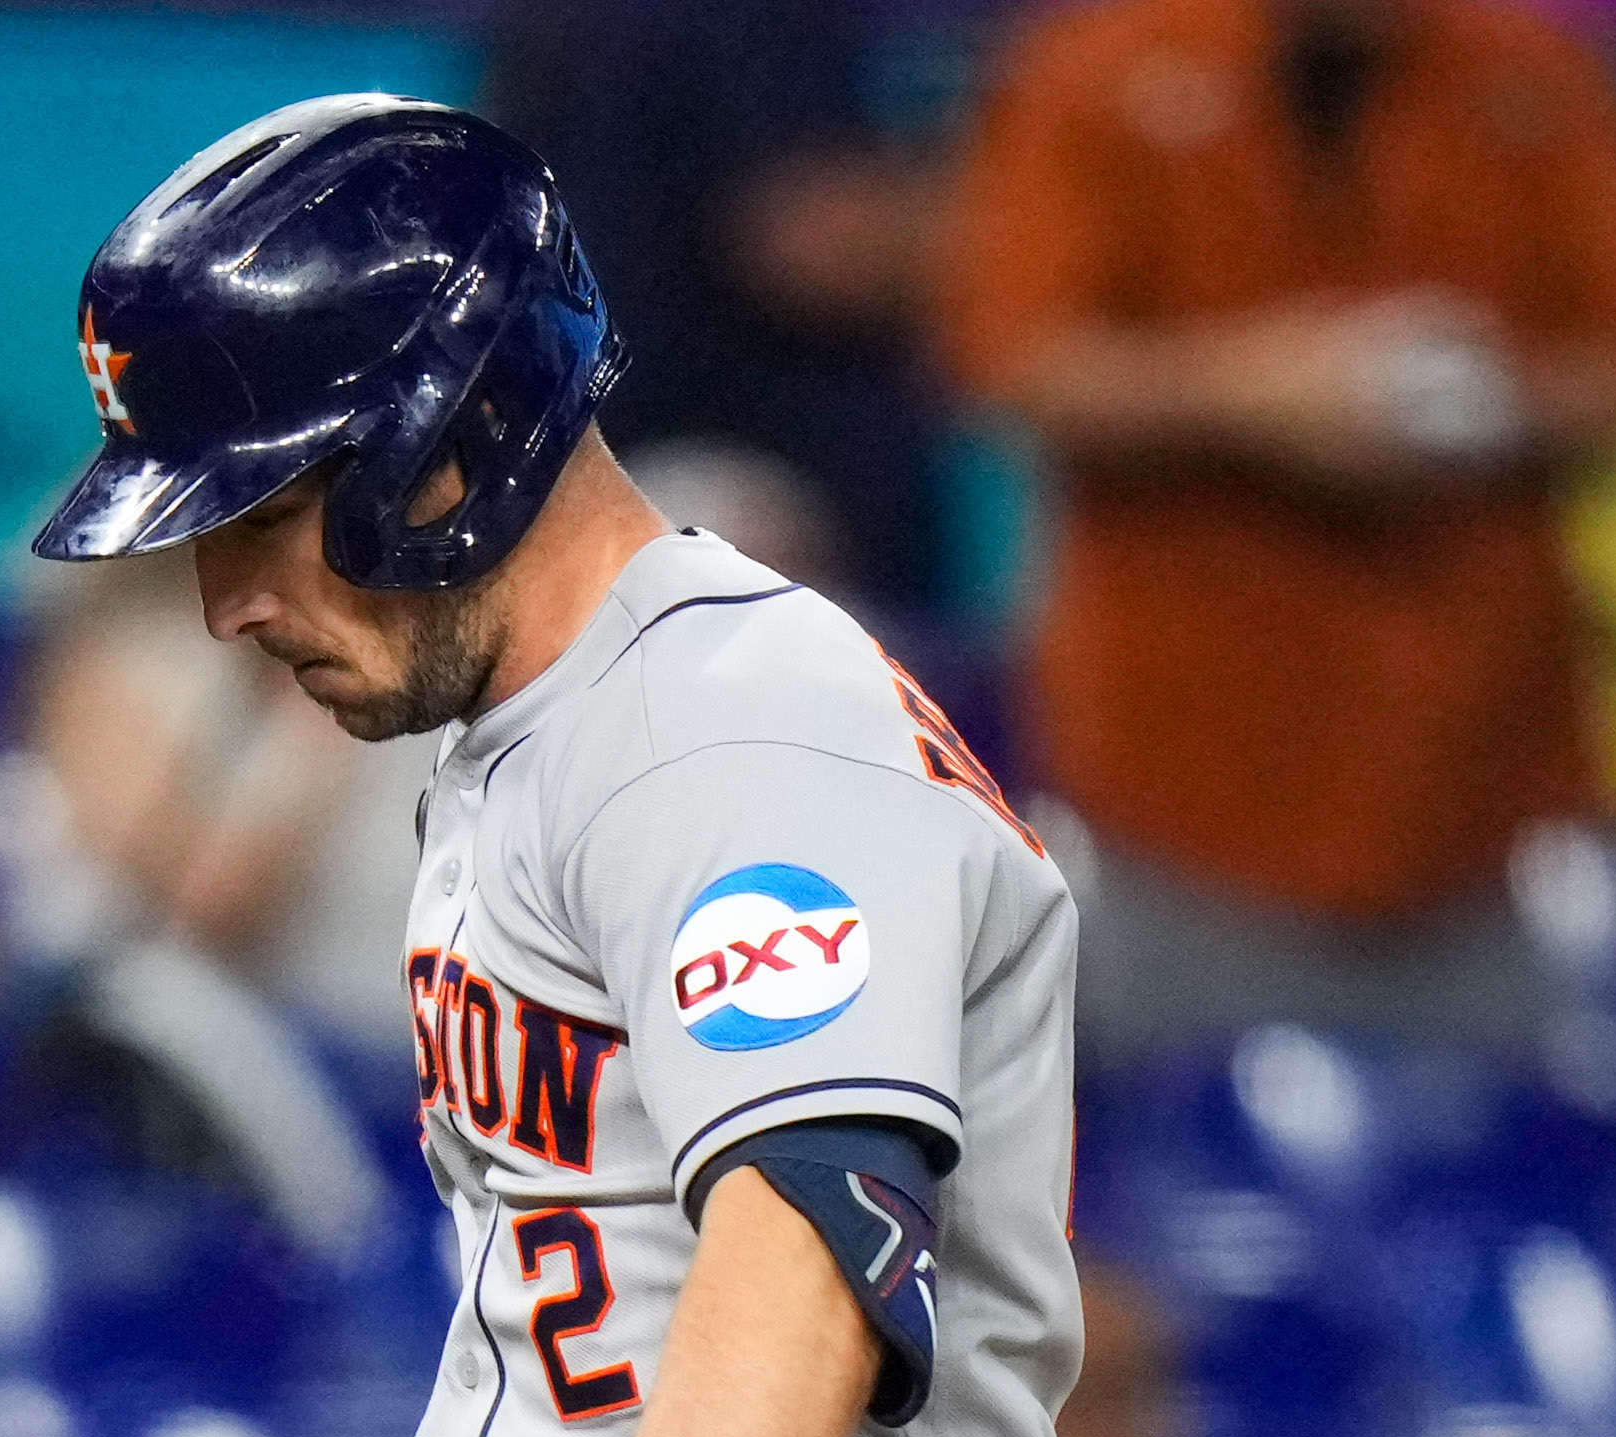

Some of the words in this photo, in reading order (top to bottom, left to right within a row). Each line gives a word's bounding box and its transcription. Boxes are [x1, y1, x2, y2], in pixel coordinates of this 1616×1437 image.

[78, 341, 128, 421] H
[675, 919, 859, 1010] OXY
[511, 1205, 641, 1422] 2
